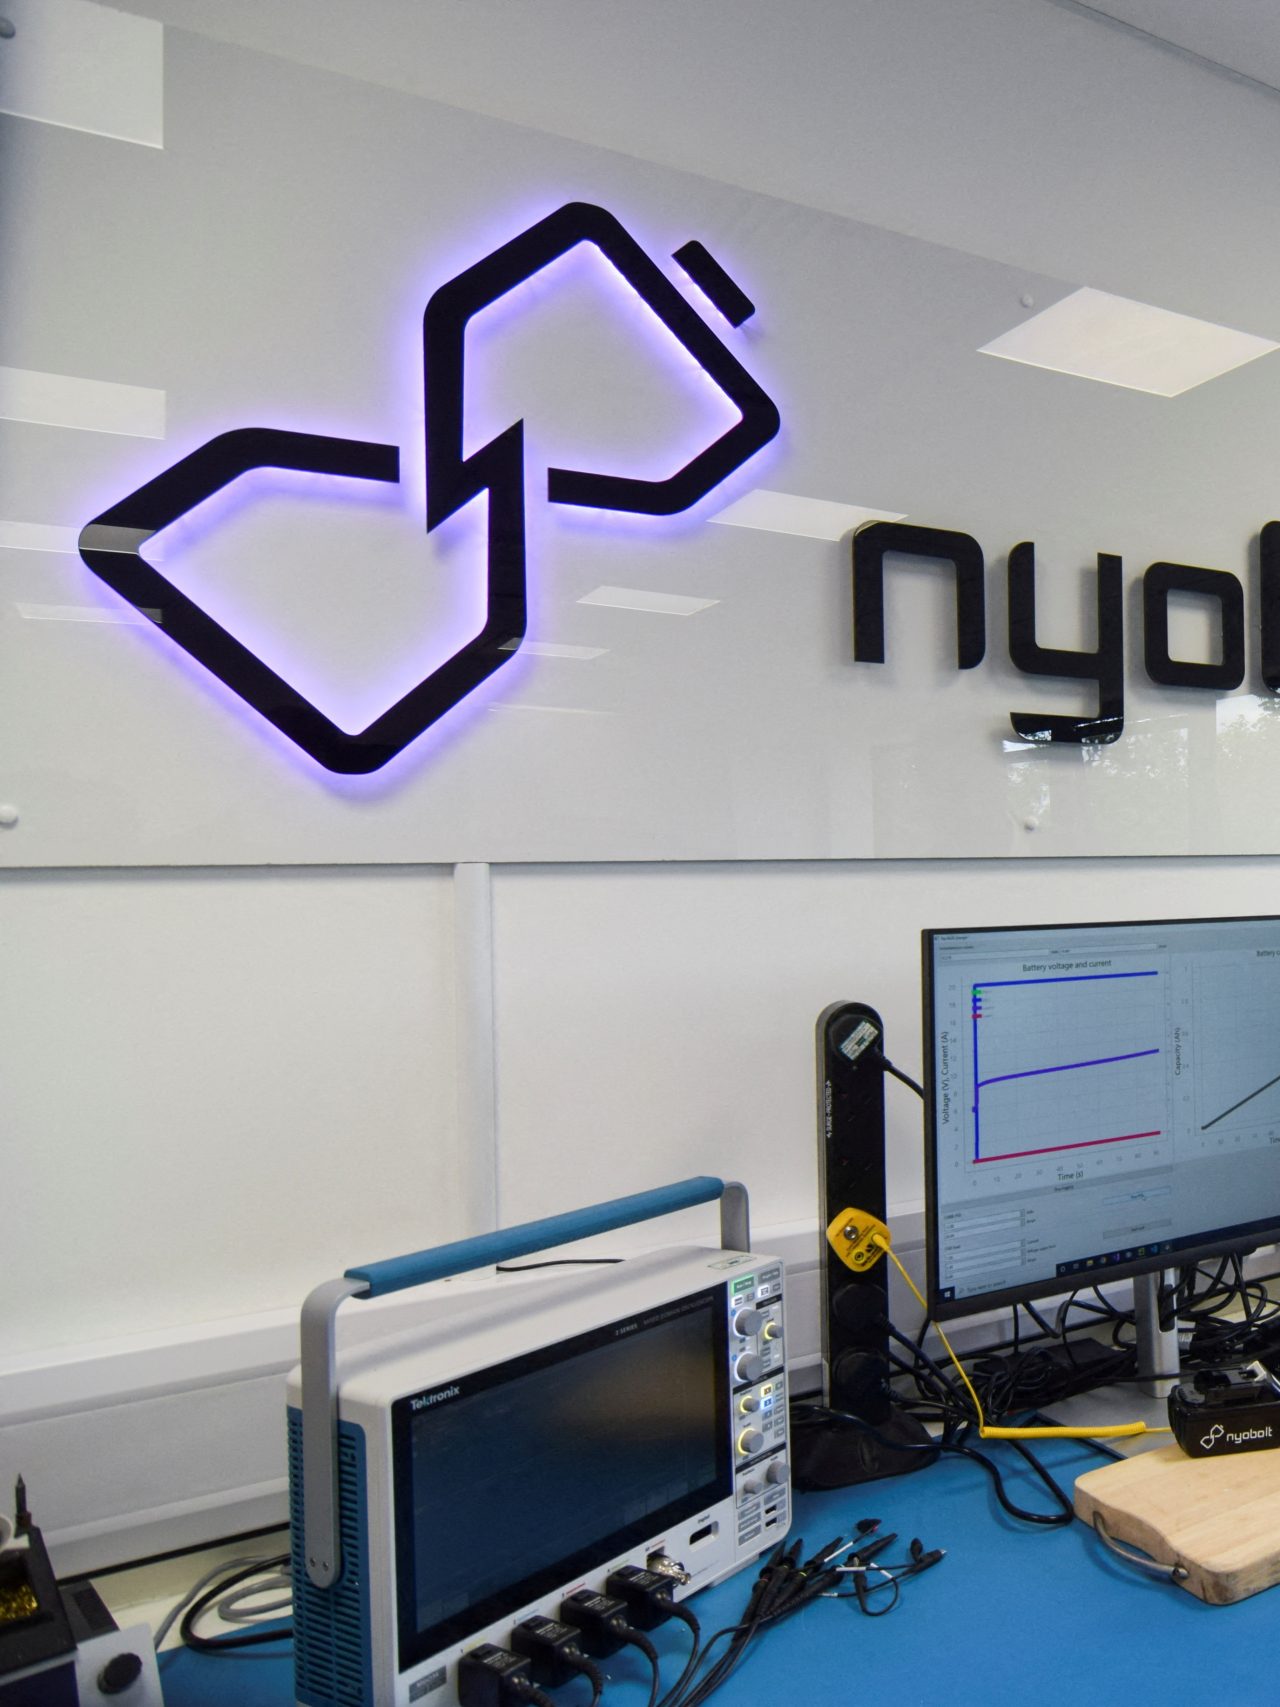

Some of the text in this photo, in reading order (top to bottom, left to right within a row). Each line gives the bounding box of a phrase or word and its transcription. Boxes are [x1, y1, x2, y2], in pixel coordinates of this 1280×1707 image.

[1256, 950, 1275, 959] Battery
[1022, 963, 1047, 973] Battery
[1048, 962, 1074, 972] voltage
[1088, 960, 1112, 968] current
[940, 1044, 949, 1076] Current
[942, 1094, 950, 1125] Voltage
[1057, 1173, 1075, 1181] Time
[410, 1386, 460, 1410] Tektronix
[1226, 1426, 1272, 1443] nyobolt
